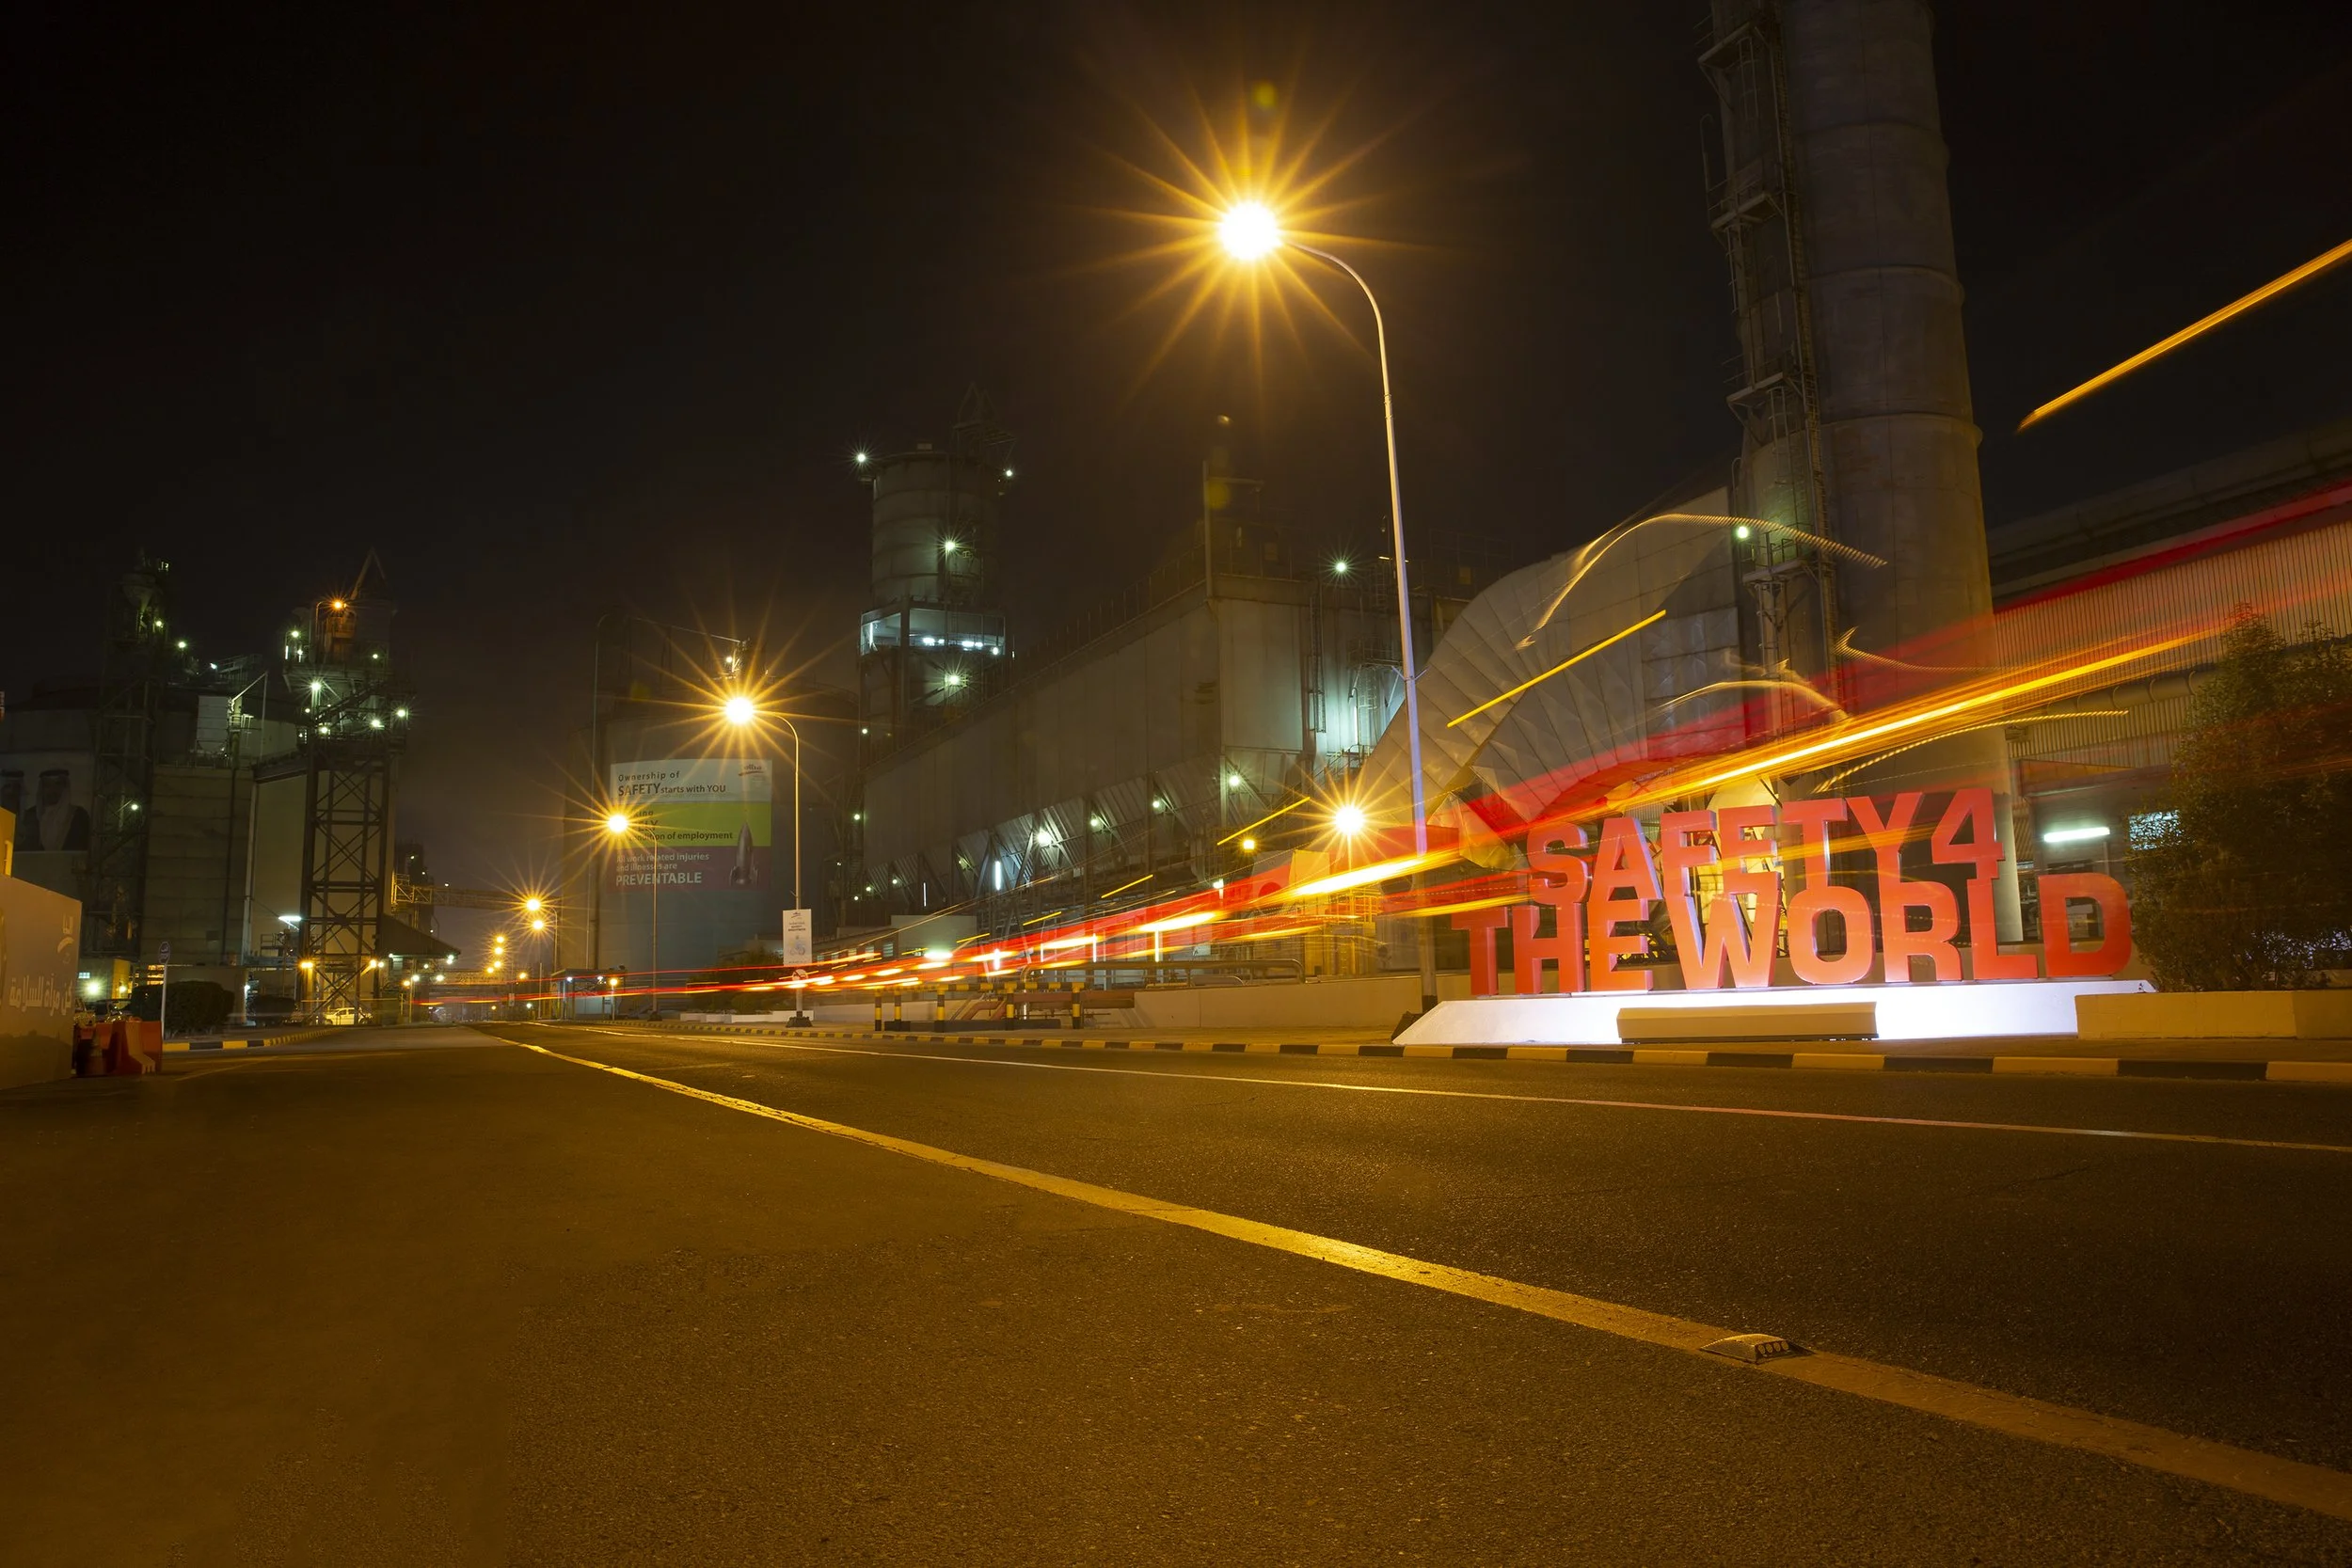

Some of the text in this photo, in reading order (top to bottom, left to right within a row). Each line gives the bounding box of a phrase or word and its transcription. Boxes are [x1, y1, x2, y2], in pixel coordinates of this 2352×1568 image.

[618, 770, 680, 782] Ownership of
[618, 783, 661, 797] SAFETY
[686, 784, 706, 793] with
[707, 784, 726, 793] YOU
[667, 832, 676, 840] of
[676, 830, 734, 842] employment
[675, 851, 710, 863] injuries
[663, 863, 678, 871] are
[616, 871, 703, 886] PREVENTABLE
[1451, 871, 2132, 995] THE WORLD
